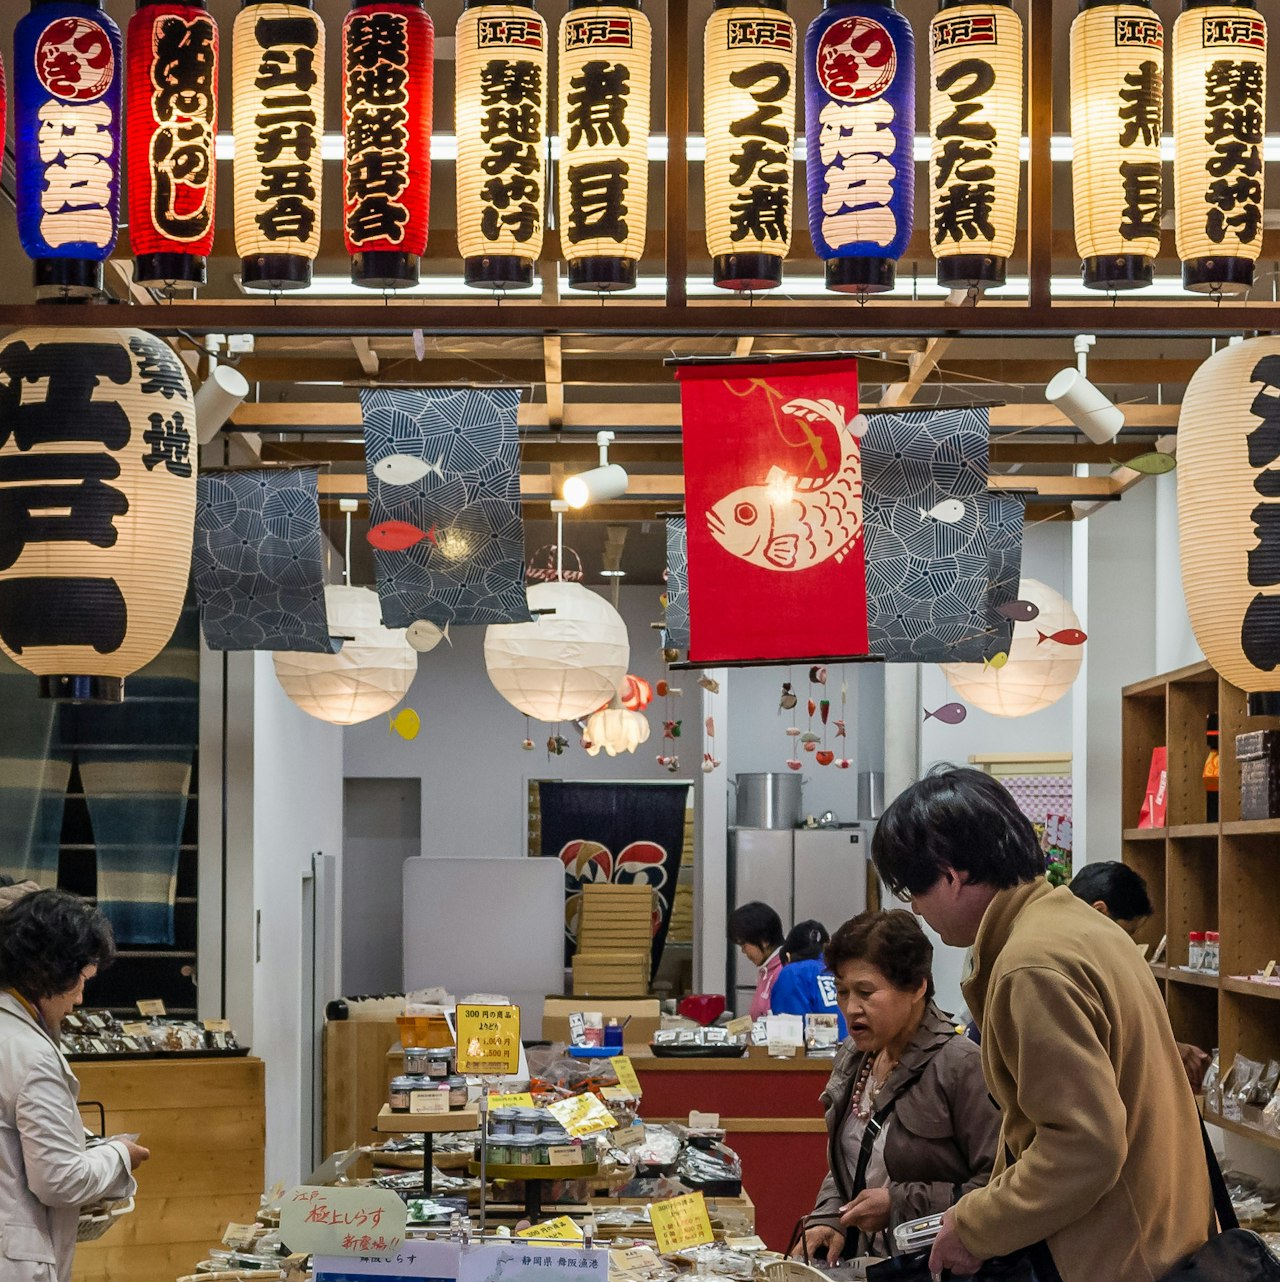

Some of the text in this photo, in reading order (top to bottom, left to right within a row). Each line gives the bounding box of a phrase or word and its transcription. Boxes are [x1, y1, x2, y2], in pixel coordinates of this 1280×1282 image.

[480, 18, 542, 49] 江戸一
[566, 17, 631, 48] 江戸一
[728, 17, 793, 49] 江戸一
[933, 16, 996, 49] 江戸一
[1205, 17, 1264, 48] 江戸一
[38, 99, 115, 250] 江戸一
[255, 17, 317, 242] 一斗二升五合
[346, 14, 410, 245] 築地銘店会
[480, 60, 541, 242] 築地みやげ
[567, 61, 631, 244] 煮豆
[729, 62, 792, 244] つくだ煮
[819, 100, 897, 249] 江戸一
[935, 58, 997, 244] つくだ煮
[1205, 60, 1264, 245] 築地みやげ
[128, 336, 193, 479] 築地
[304, 1204, 385, 1229] 極上しらす
[521, 1255, 600, 1270] 静岡県 舞阪漁港
